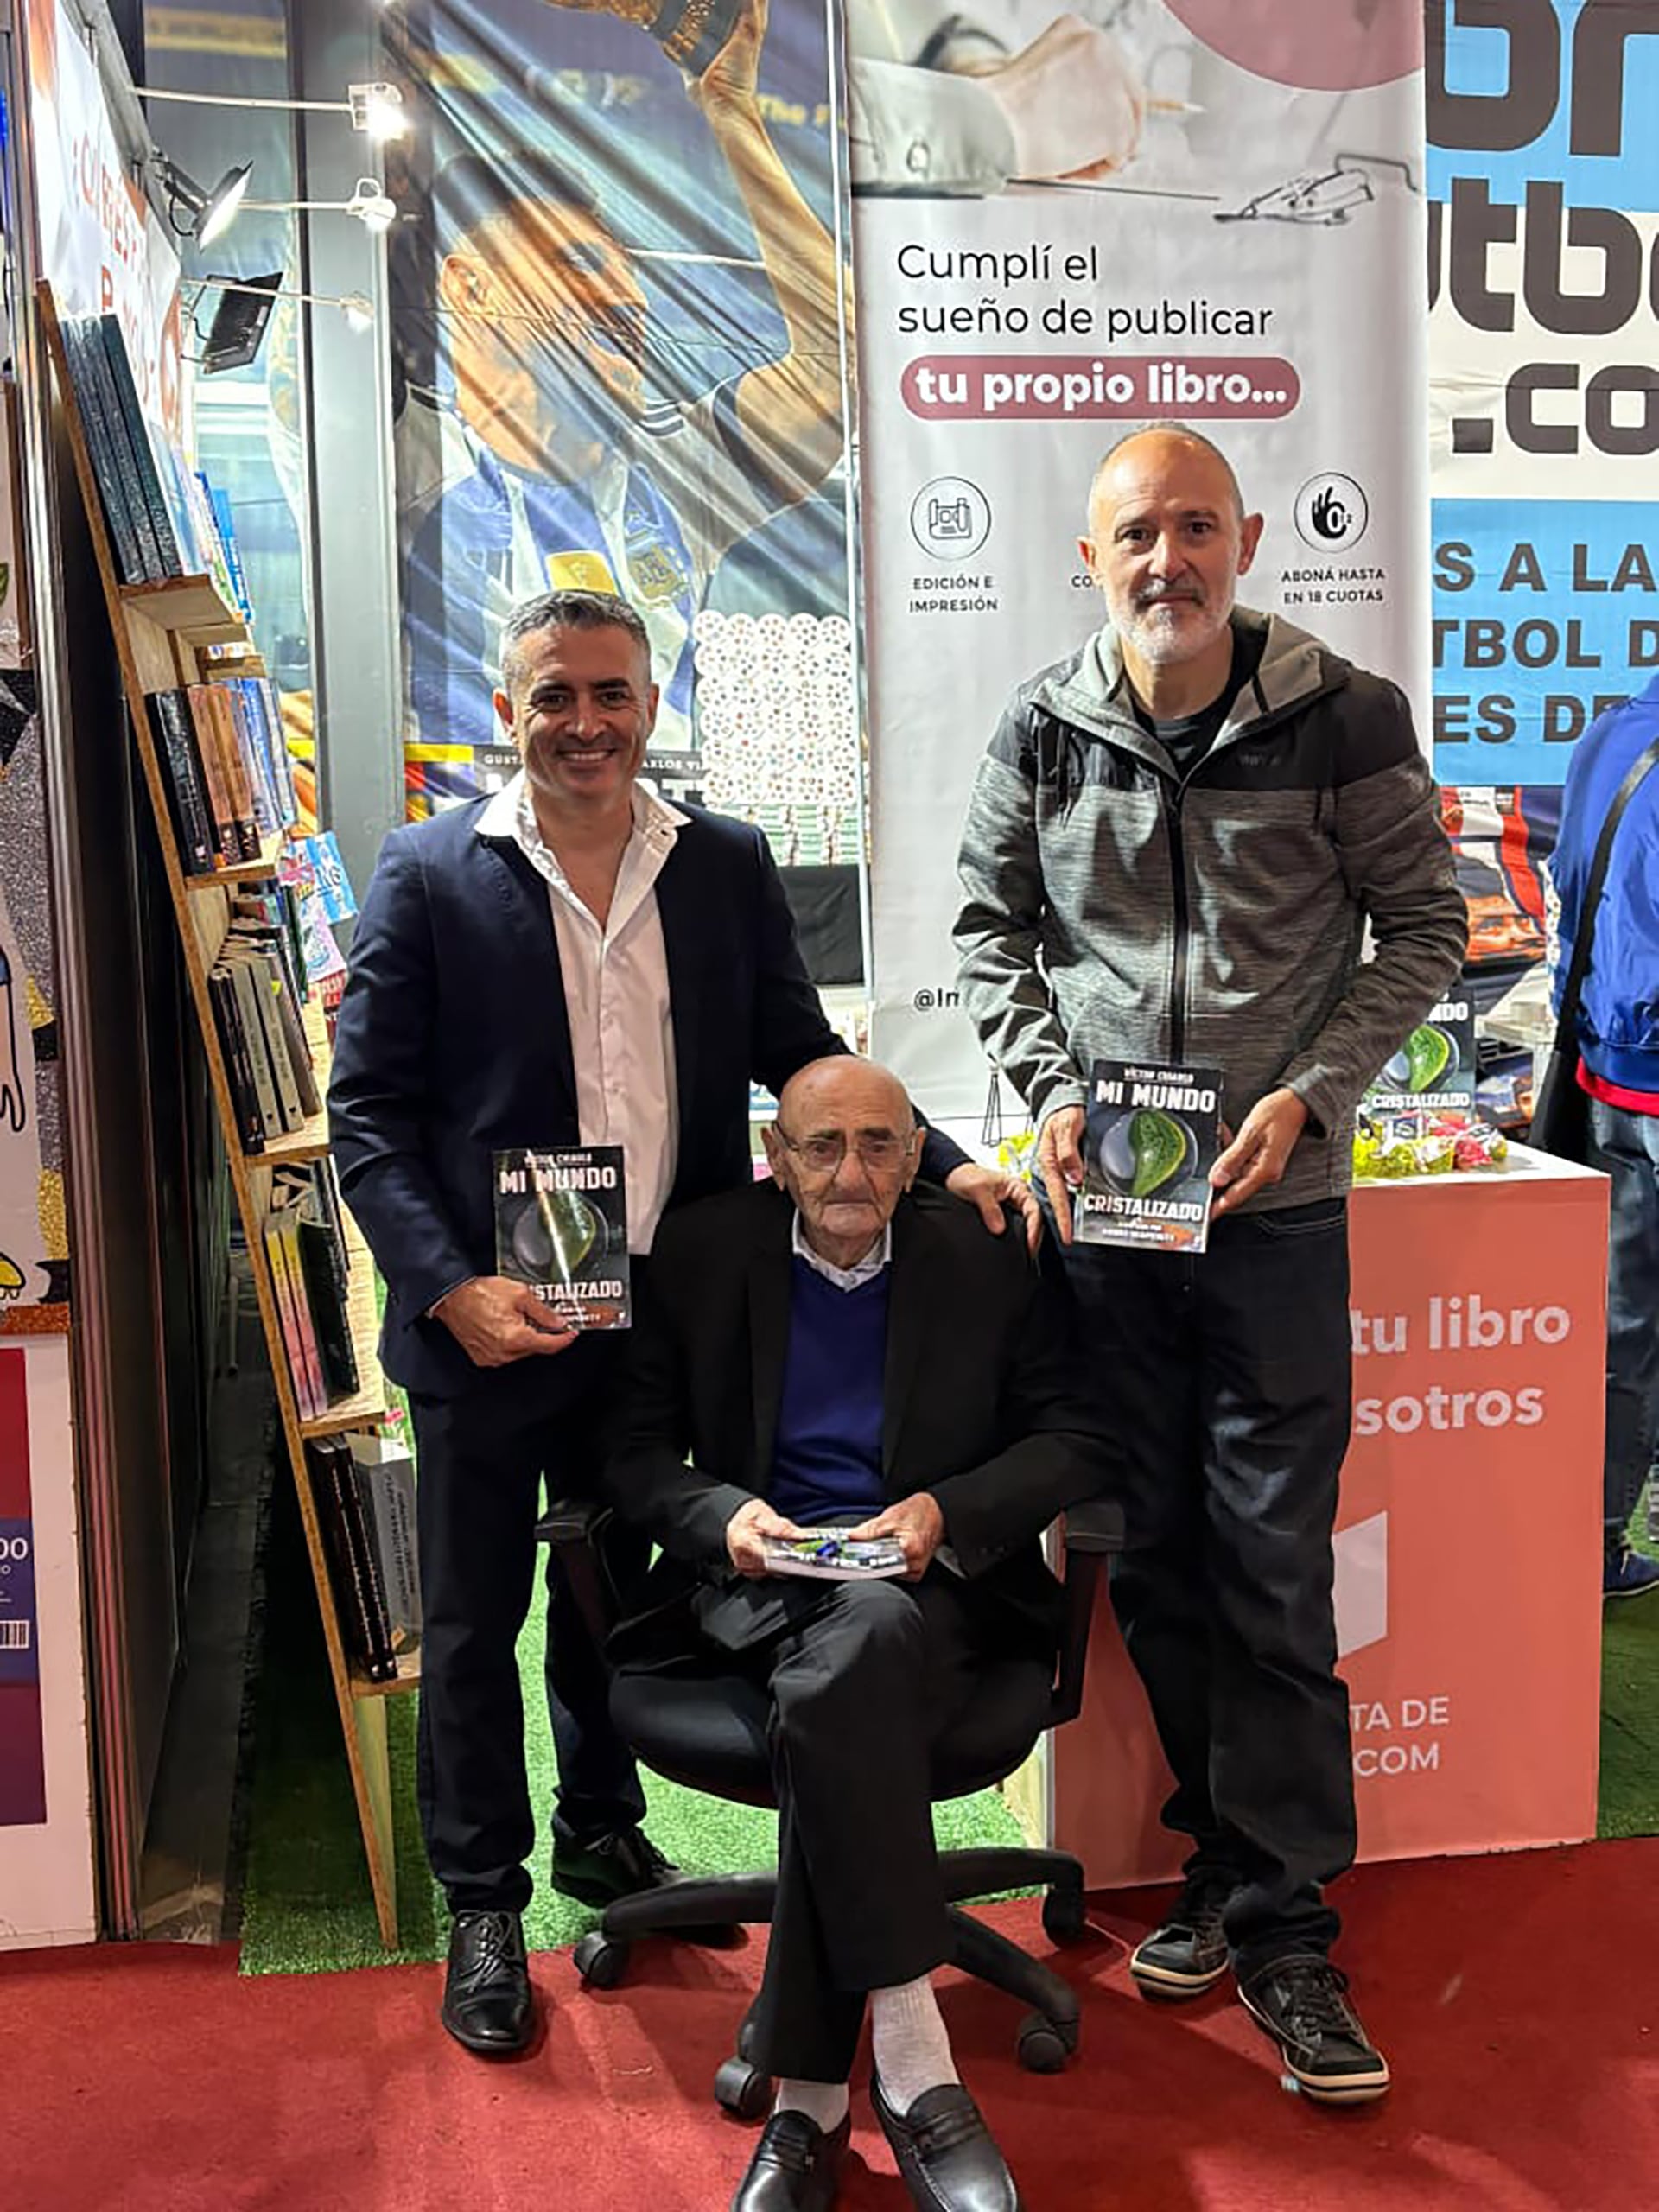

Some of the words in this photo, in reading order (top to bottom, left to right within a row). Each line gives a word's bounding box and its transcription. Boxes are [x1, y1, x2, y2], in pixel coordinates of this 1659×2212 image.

[898, 245, 1052, 287] Cumplí
[1065, 245, 1097, 280] el
[898, 298, 1029, 334] sueño
[1042, 299, 1093, 334] de
[1109, 301, 1273, 342] publicar
[916, 368, 967, 404] tu
[983, 361, 1134, 410] propio
[1148, 362, 1287, 404] libro...
[913, 574, 979, 590] EDICIÓN
[984, 576, 993, 588] E
[1281, 567, 1335, 582] ABONÁ
[1339, 569, 1385, 582] HASTA
[1433, 542, 1475, 592] S
[1499, 543, 1546, 592] A
[1573, 543, 1656, 592] LA
[910, 595, 998, 613] IMPRESIÓN
[1284, 593, 1303, 604] EN
[1326, 589, 1383, 603] CUOTAS
[1433, 694, 1517, 744] ES
[1096, 1080, 1123, 1104] MI
[1131, 1083, 1216, 1112] MUNDO
[1371, 1093, 1470, 1109] CRISTALIZADO
[500, 1171, 526, 1194] MI
[535, 1166, 616, 1192] MUNDO
[1084, 1194, 1204, 1221] CRISTALIZADO
[1351, 1309, 1407, 1356] tu
[1428, 1294, 1571, 1350] libro
[1354, 1385, 1545, 1435] sotros
[1401, 1697, 1450, 1729] DE
[1353, 1743, 1440, 1777] COM
